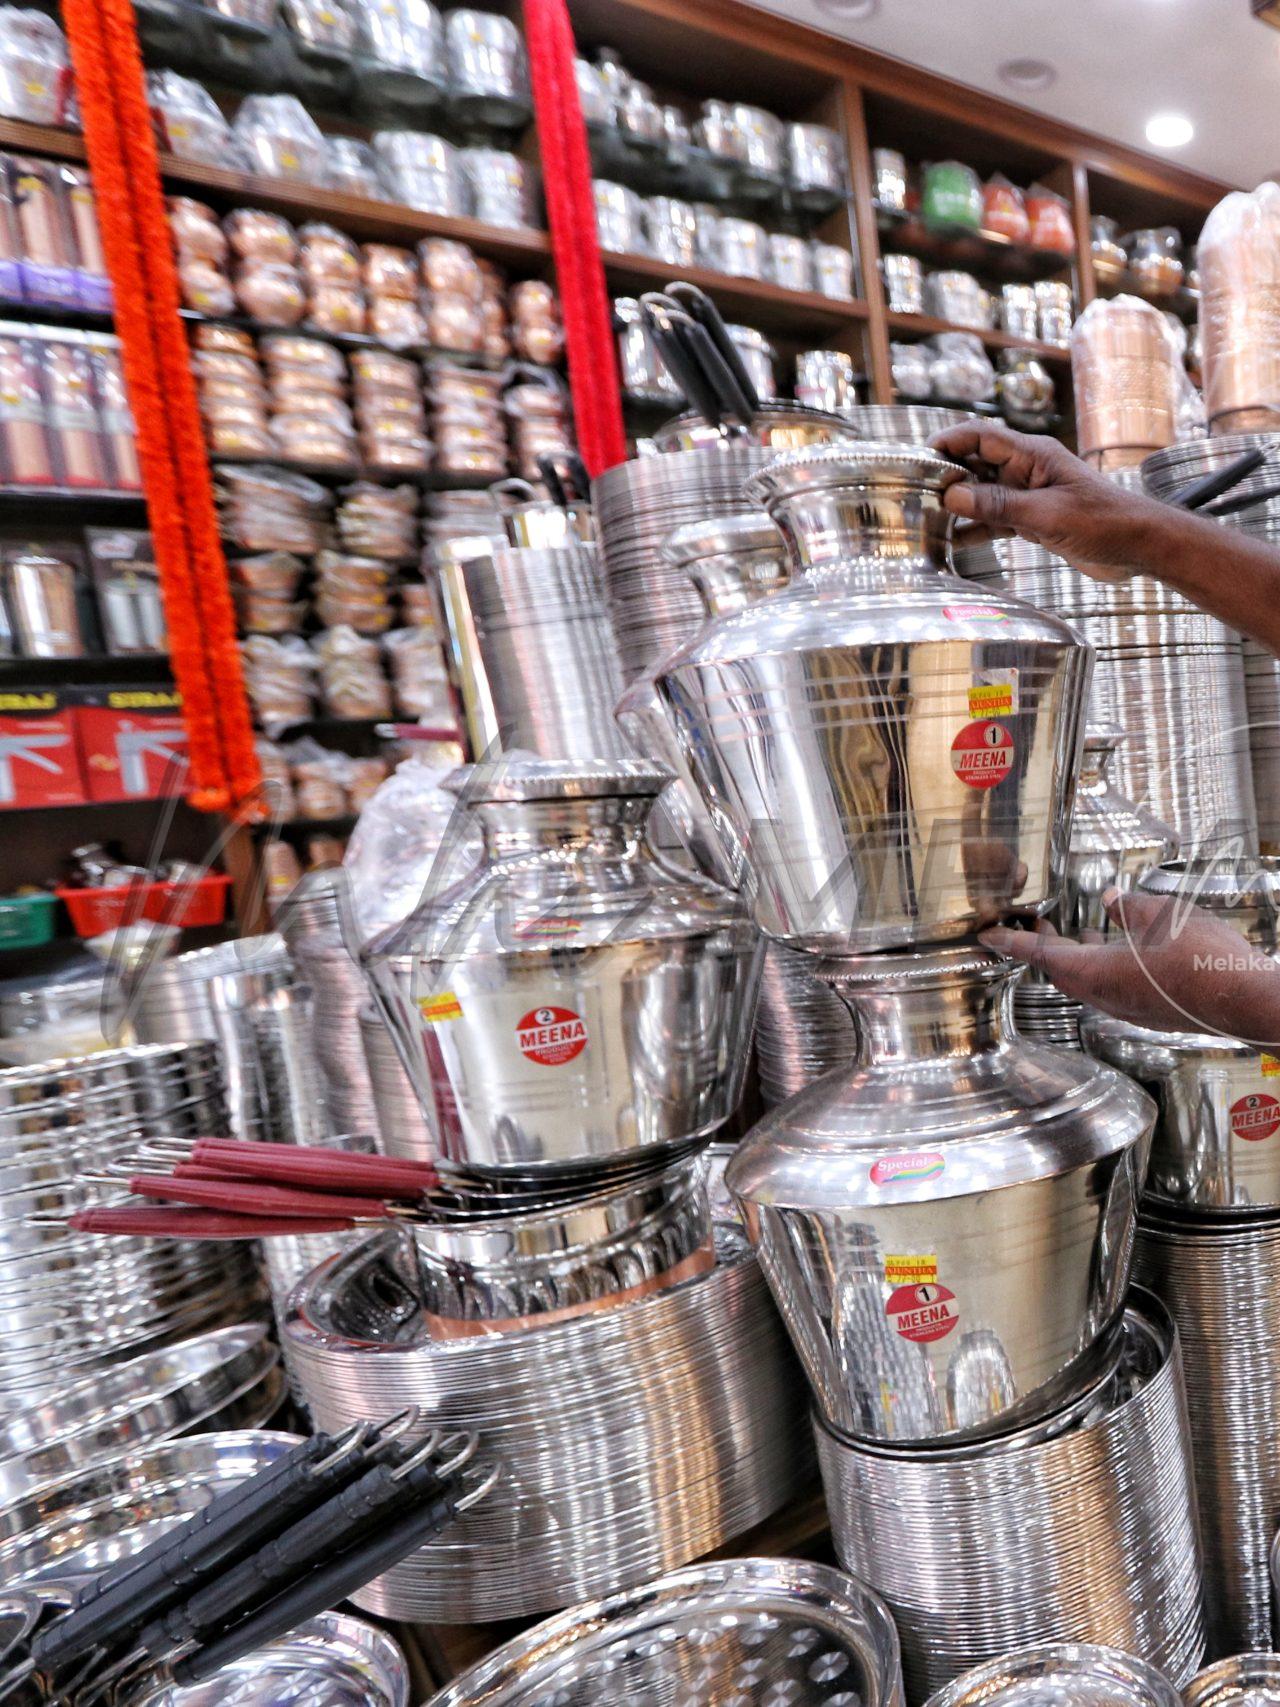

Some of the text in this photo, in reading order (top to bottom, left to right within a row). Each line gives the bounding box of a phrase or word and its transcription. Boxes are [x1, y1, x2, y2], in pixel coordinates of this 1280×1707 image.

[989, 727, 997, 744] 1
[961, 750, 1006, 769] MEENA
[540, 1009, 551, 1022] 2
[520, 1021, 585, 1048] MEENA
[1249, 1097, 1257, 1107] 2
[1232, 1106, 1280, 1127] MEENA
[878, 1157, 928, 1172] Special
[919, 1287, 930, 1302] 1
[897, 1304, 950, 1330] MEENA
